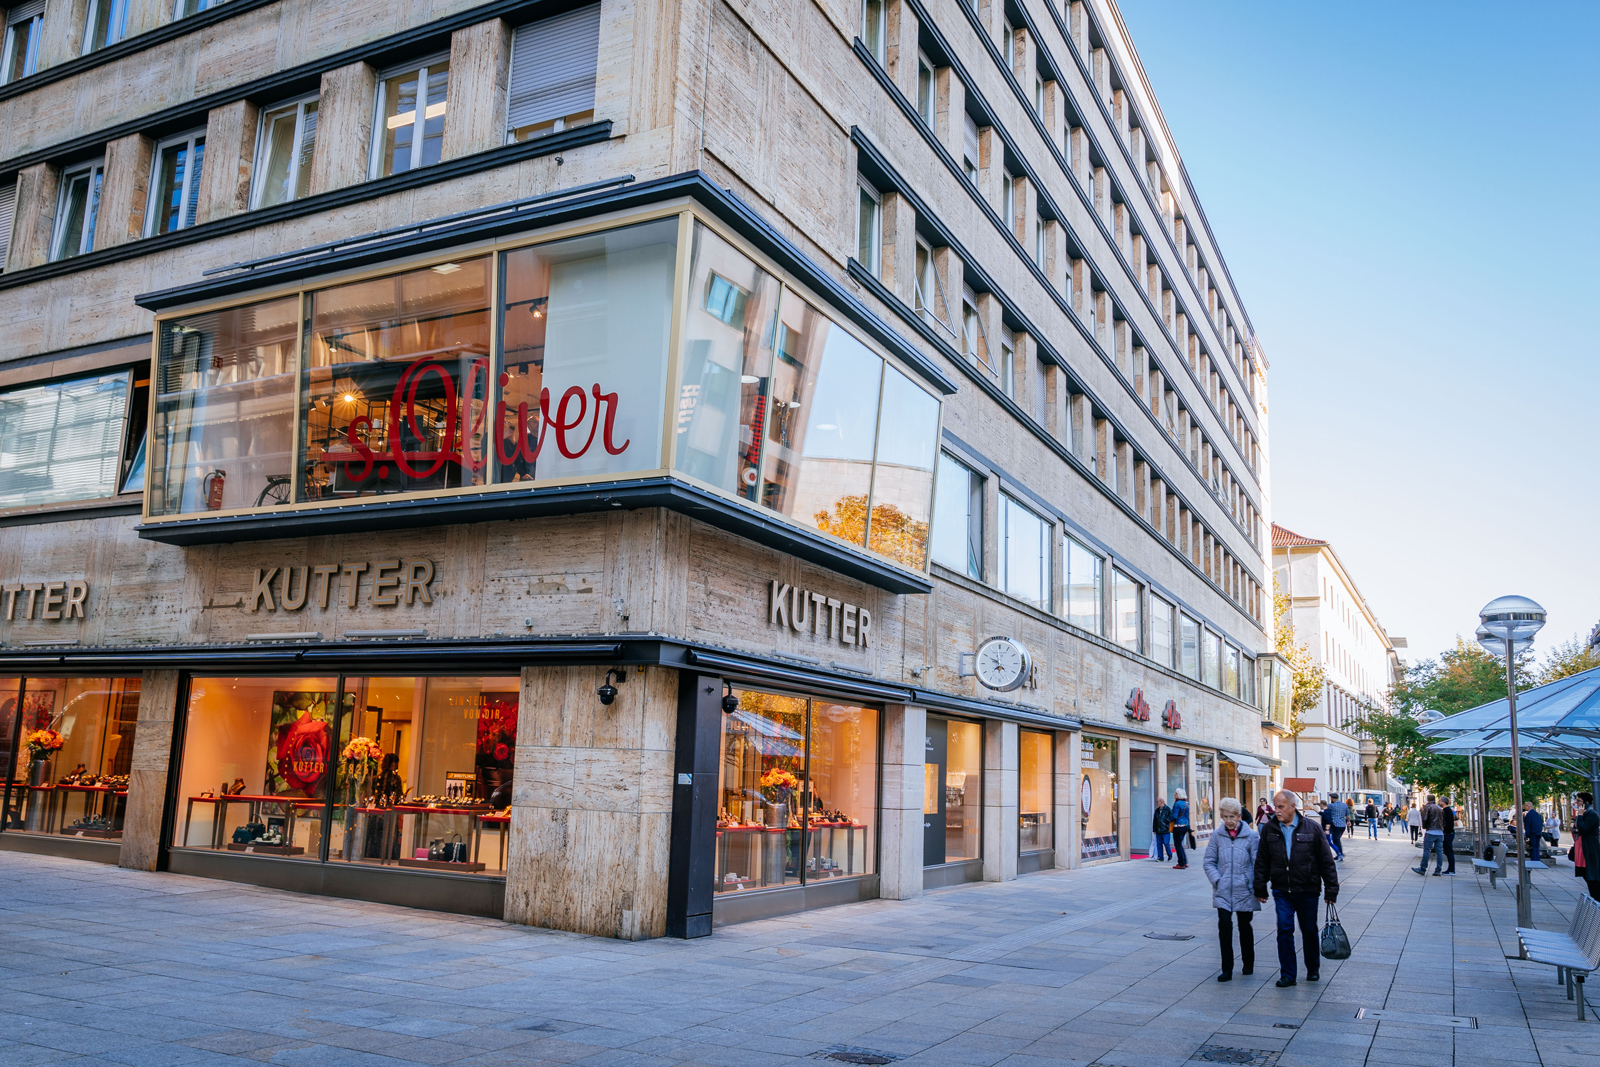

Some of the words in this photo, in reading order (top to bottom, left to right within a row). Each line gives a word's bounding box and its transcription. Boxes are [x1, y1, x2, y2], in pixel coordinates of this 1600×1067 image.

[250, 557, 436, 612] KUTTER
[0, 580, 88, 622] TTER
[769, 580, 873, 649] KUTTER
[449, 695, 465, 707] EIN
[469, 695, 487, 706] TEIL
[464, 709, 480, 720] VON
[293, 761, 324, 773] KUTTER
